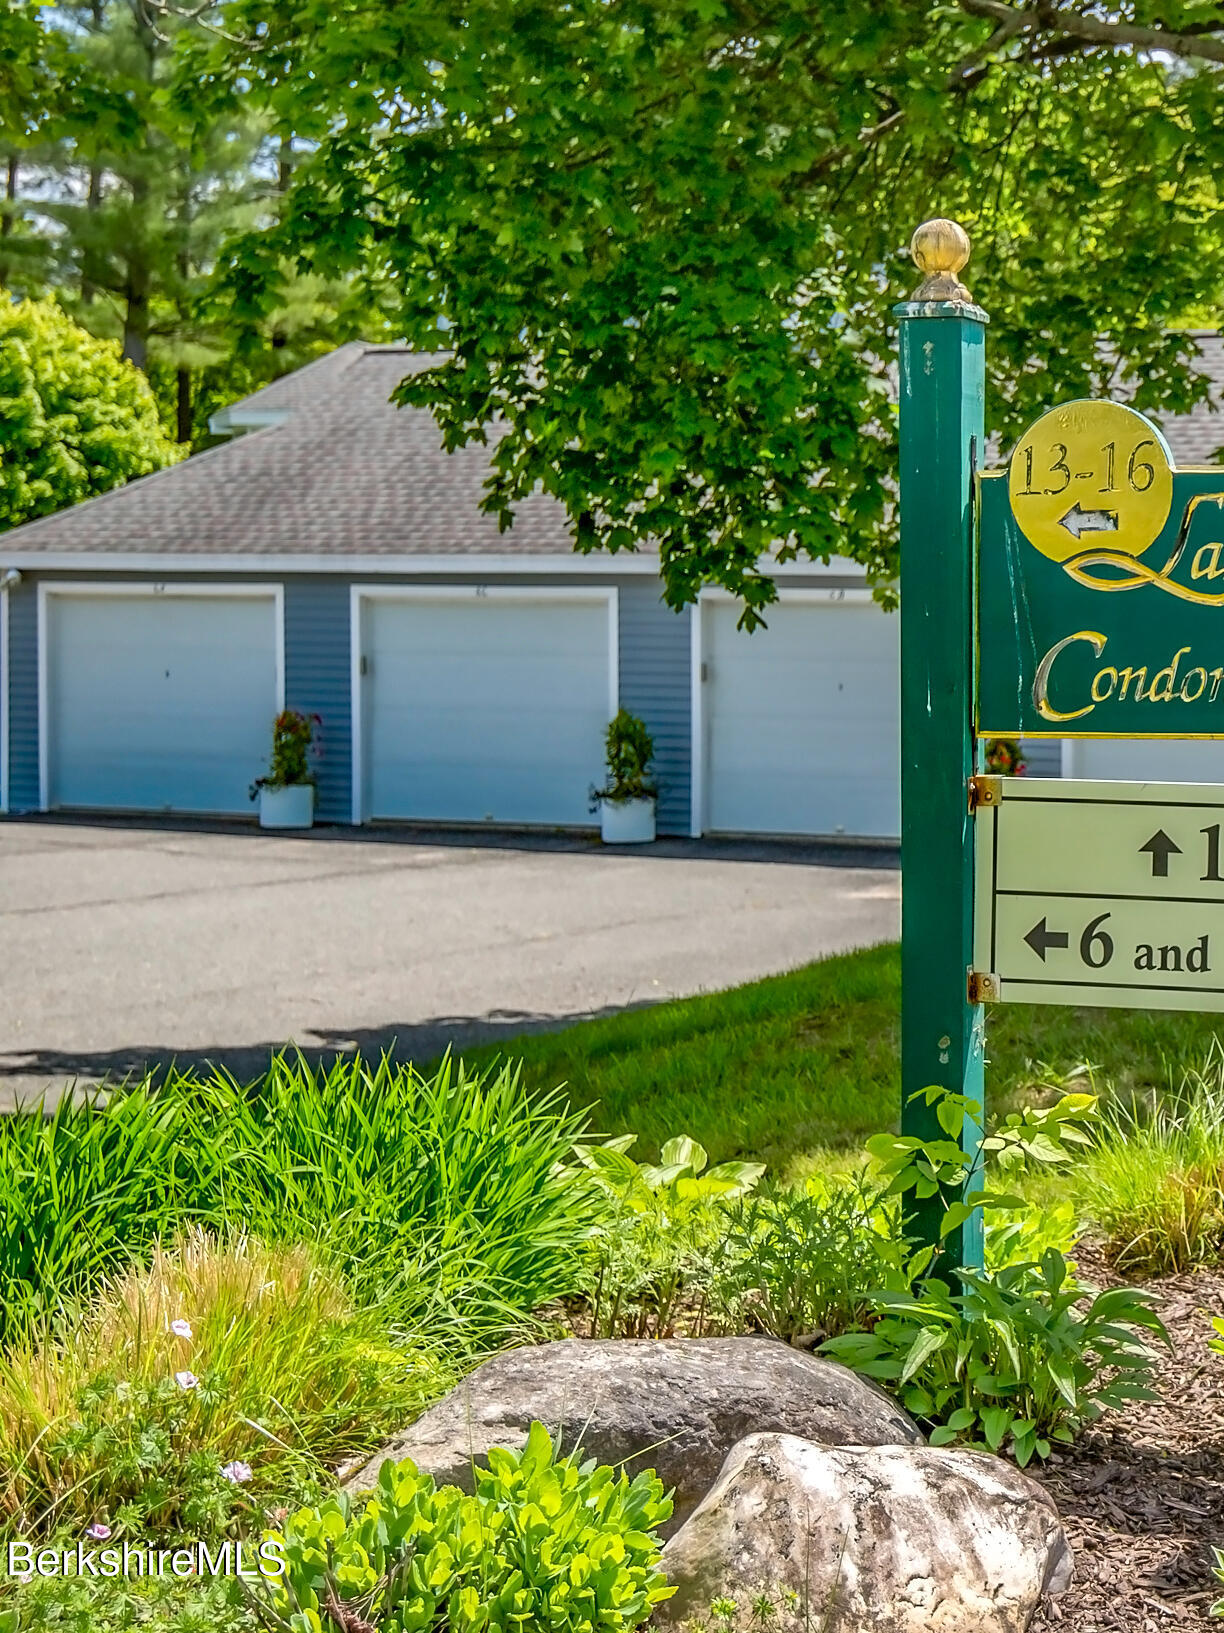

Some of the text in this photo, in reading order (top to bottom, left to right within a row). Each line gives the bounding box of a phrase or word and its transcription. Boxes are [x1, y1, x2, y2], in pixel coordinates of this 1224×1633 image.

[1016, 439, 1155, 496] 13-16
[1079, 911, 1115, 969] 6
[1133, 934, 1212, 974] and
